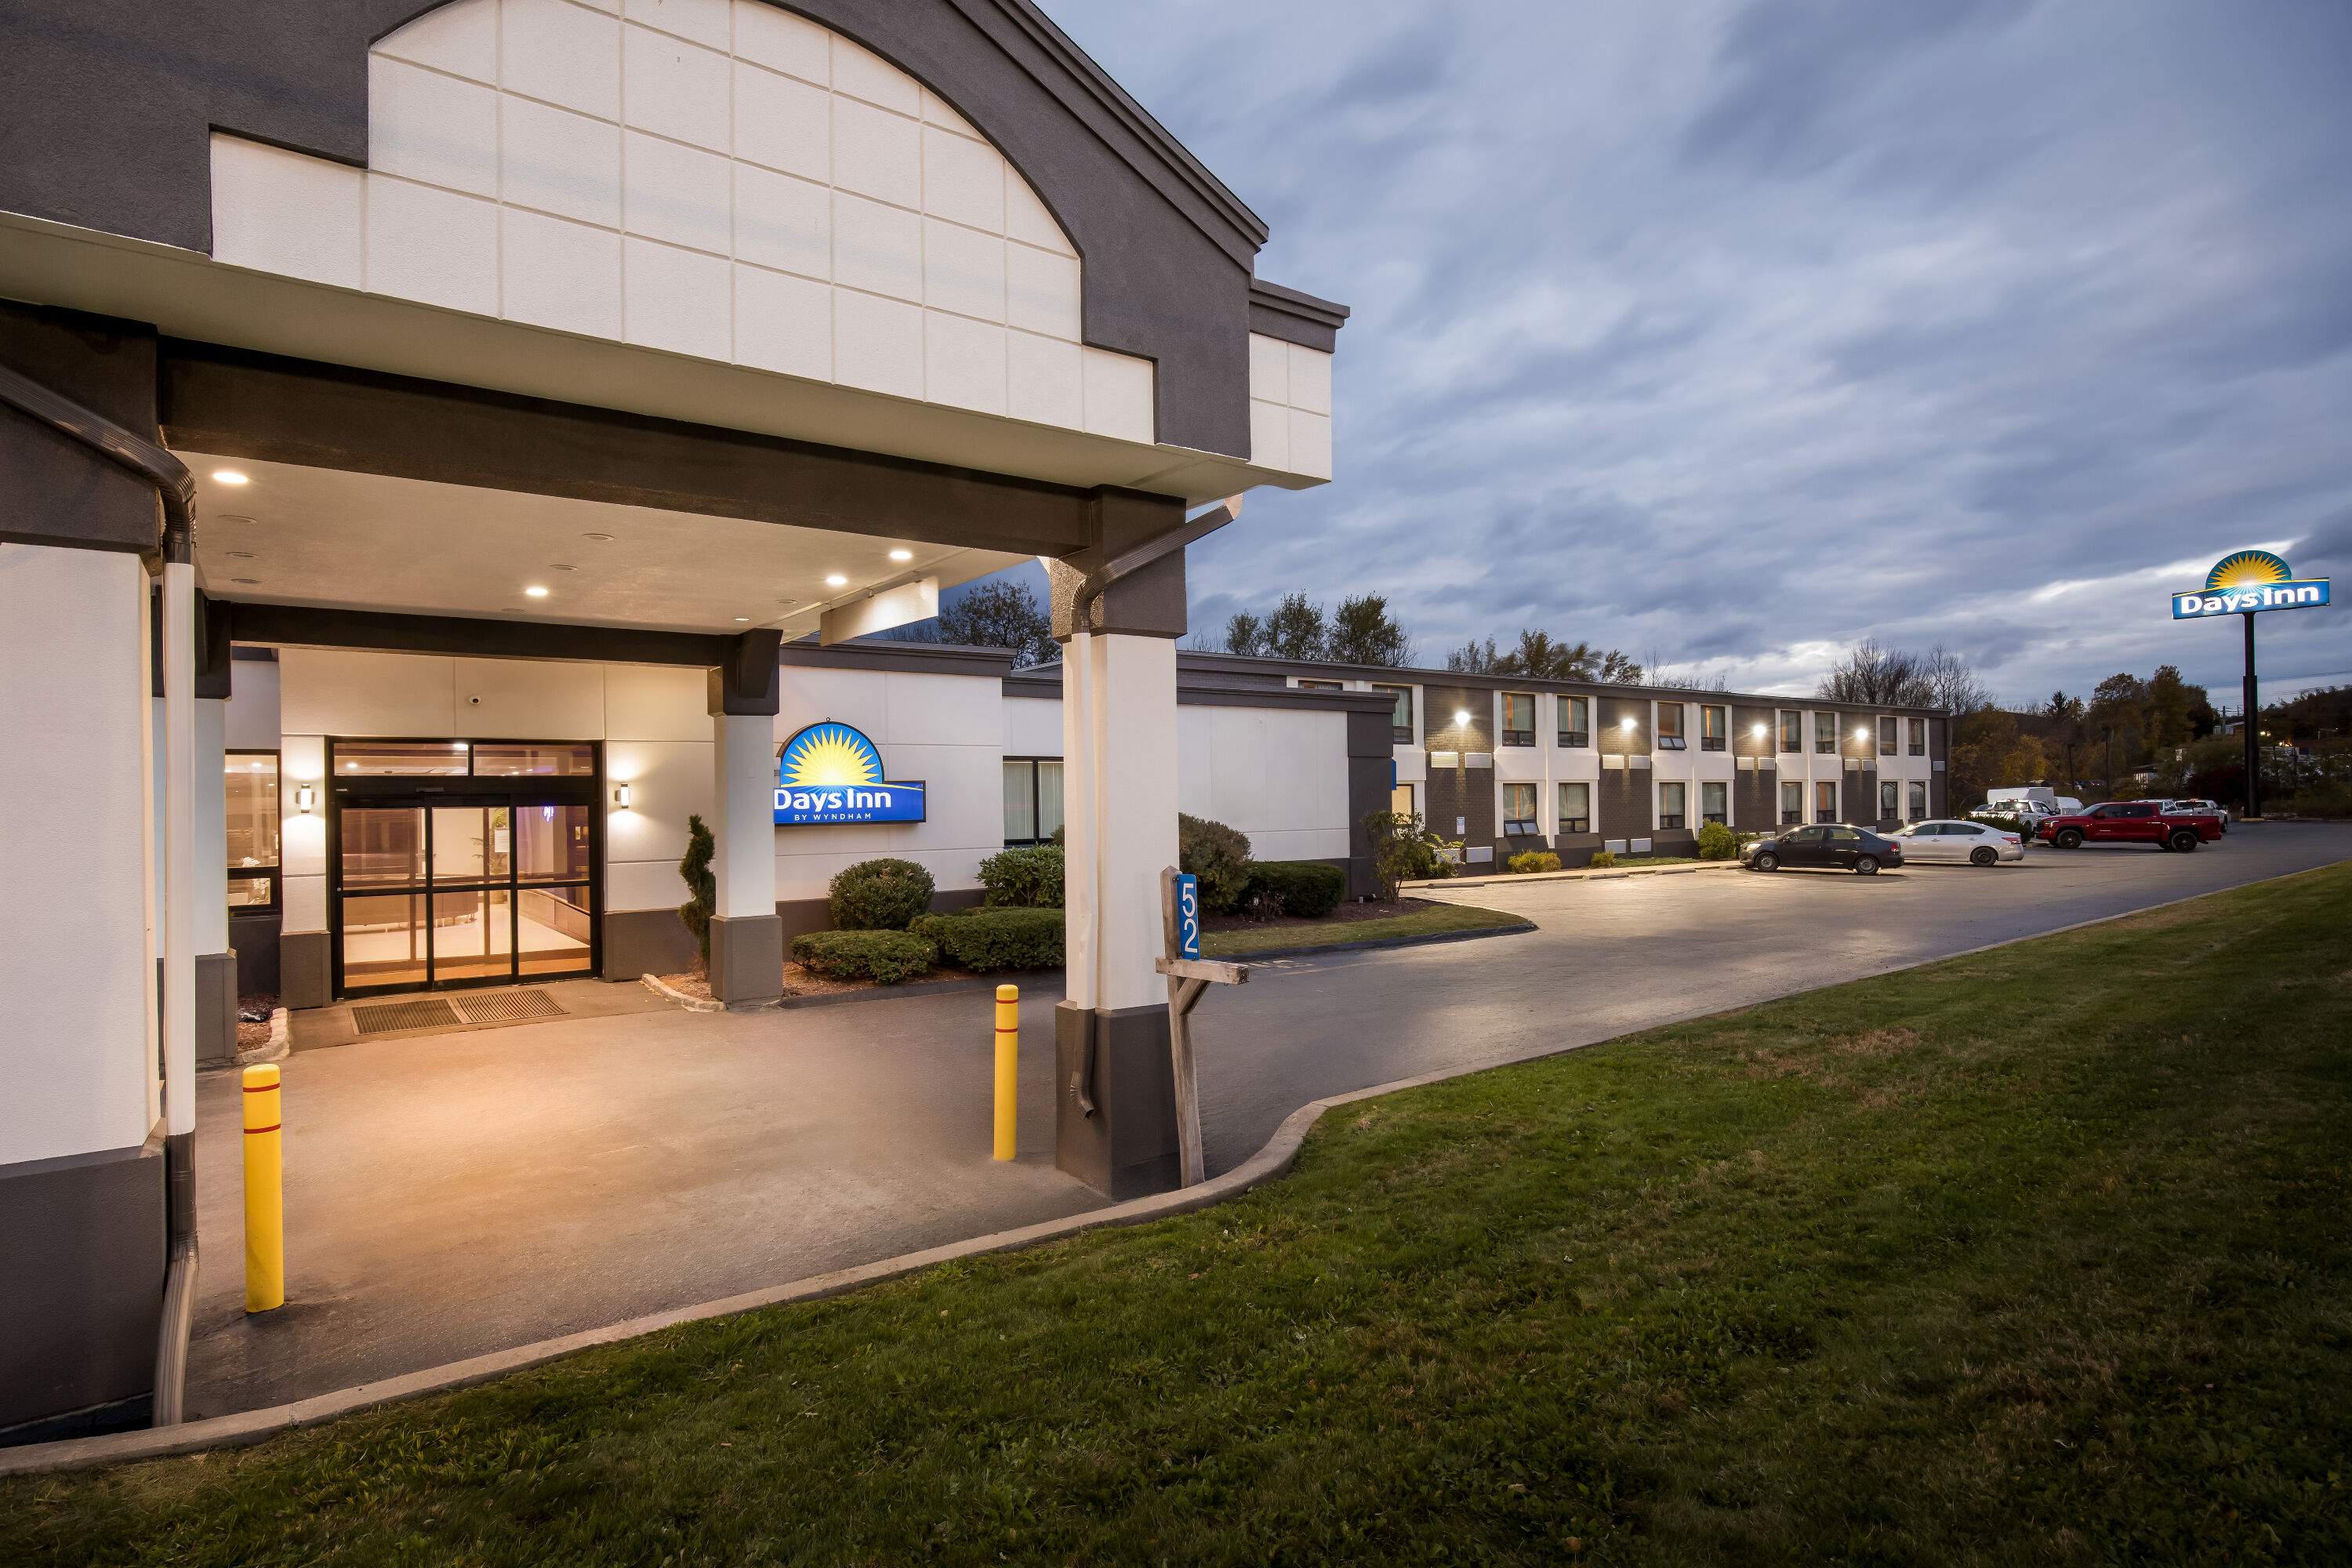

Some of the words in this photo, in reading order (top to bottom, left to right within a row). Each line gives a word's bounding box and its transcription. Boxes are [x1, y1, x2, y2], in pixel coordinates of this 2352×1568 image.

[2181, 592, 2258, 614] Days
[2263, 586, 2318, 605] Inn
[774, 788, 843, 812] Days
[847, 789, 891, 808] Inn
[813, 812, 872, 821] WYNDHAM
[1182, 883, 1197, 953] 52
